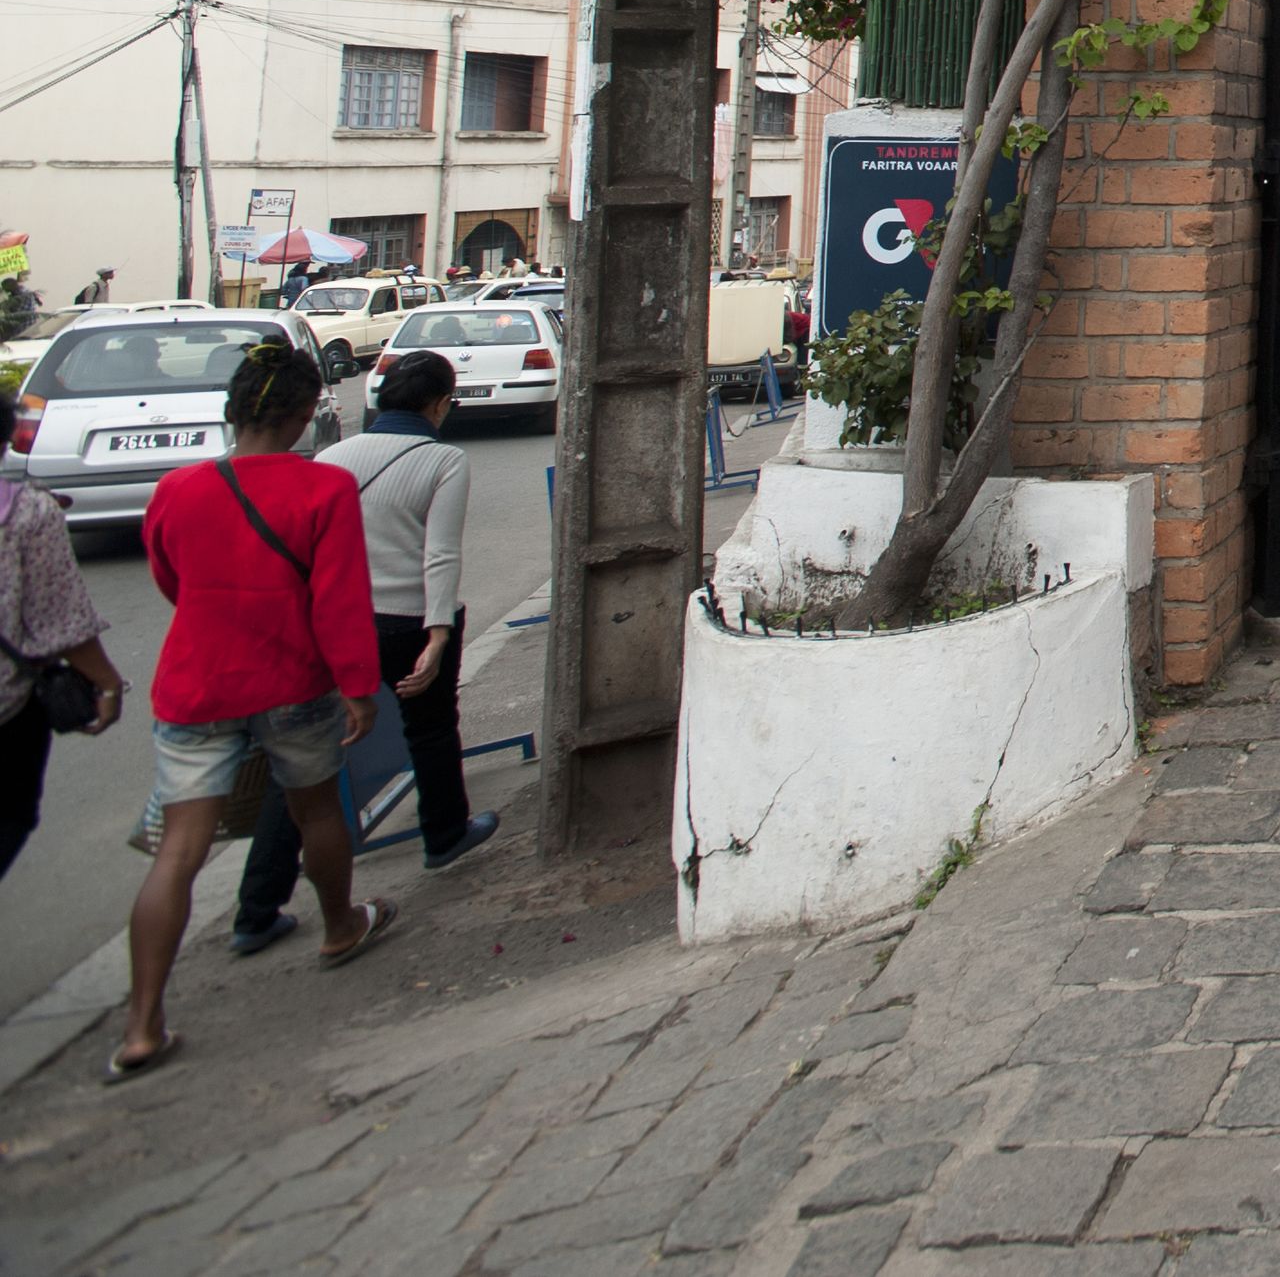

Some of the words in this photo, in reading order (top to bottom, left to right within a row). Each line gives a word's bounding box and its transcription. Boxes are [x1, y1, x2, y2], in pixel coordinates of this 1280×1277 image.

[862, 160, 913, 171] FARITRA
[117, 434, 157, 450] 2644
[169, 432, 197, 447] TBF
